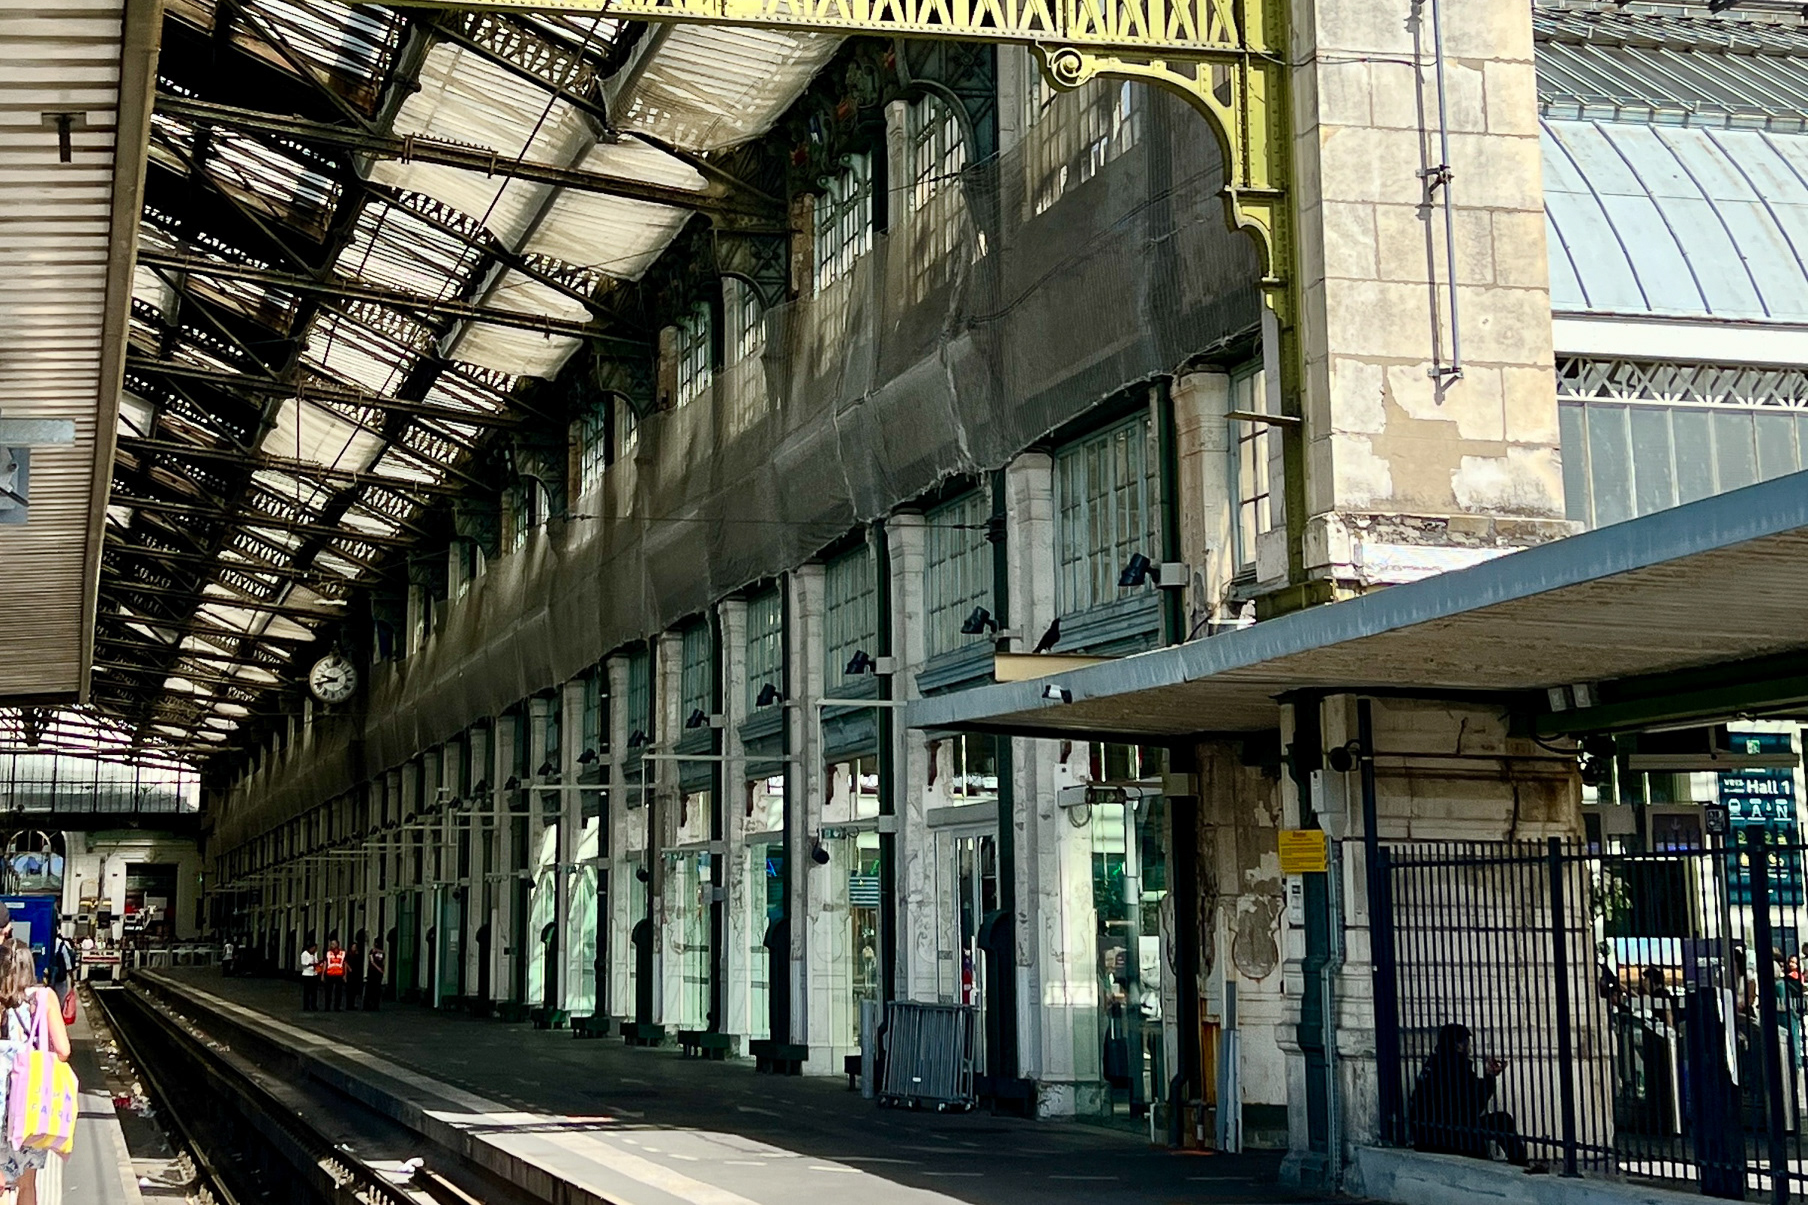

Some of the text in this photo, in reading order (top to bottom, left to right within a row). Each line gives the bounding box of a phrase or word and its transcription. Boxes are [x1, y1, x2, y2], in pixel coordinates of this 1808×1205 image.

[1746, 779, 1779, 795] Hall
[1781, 780, 1790, 795] 1
[1751, 804, 1788, 819] A N
